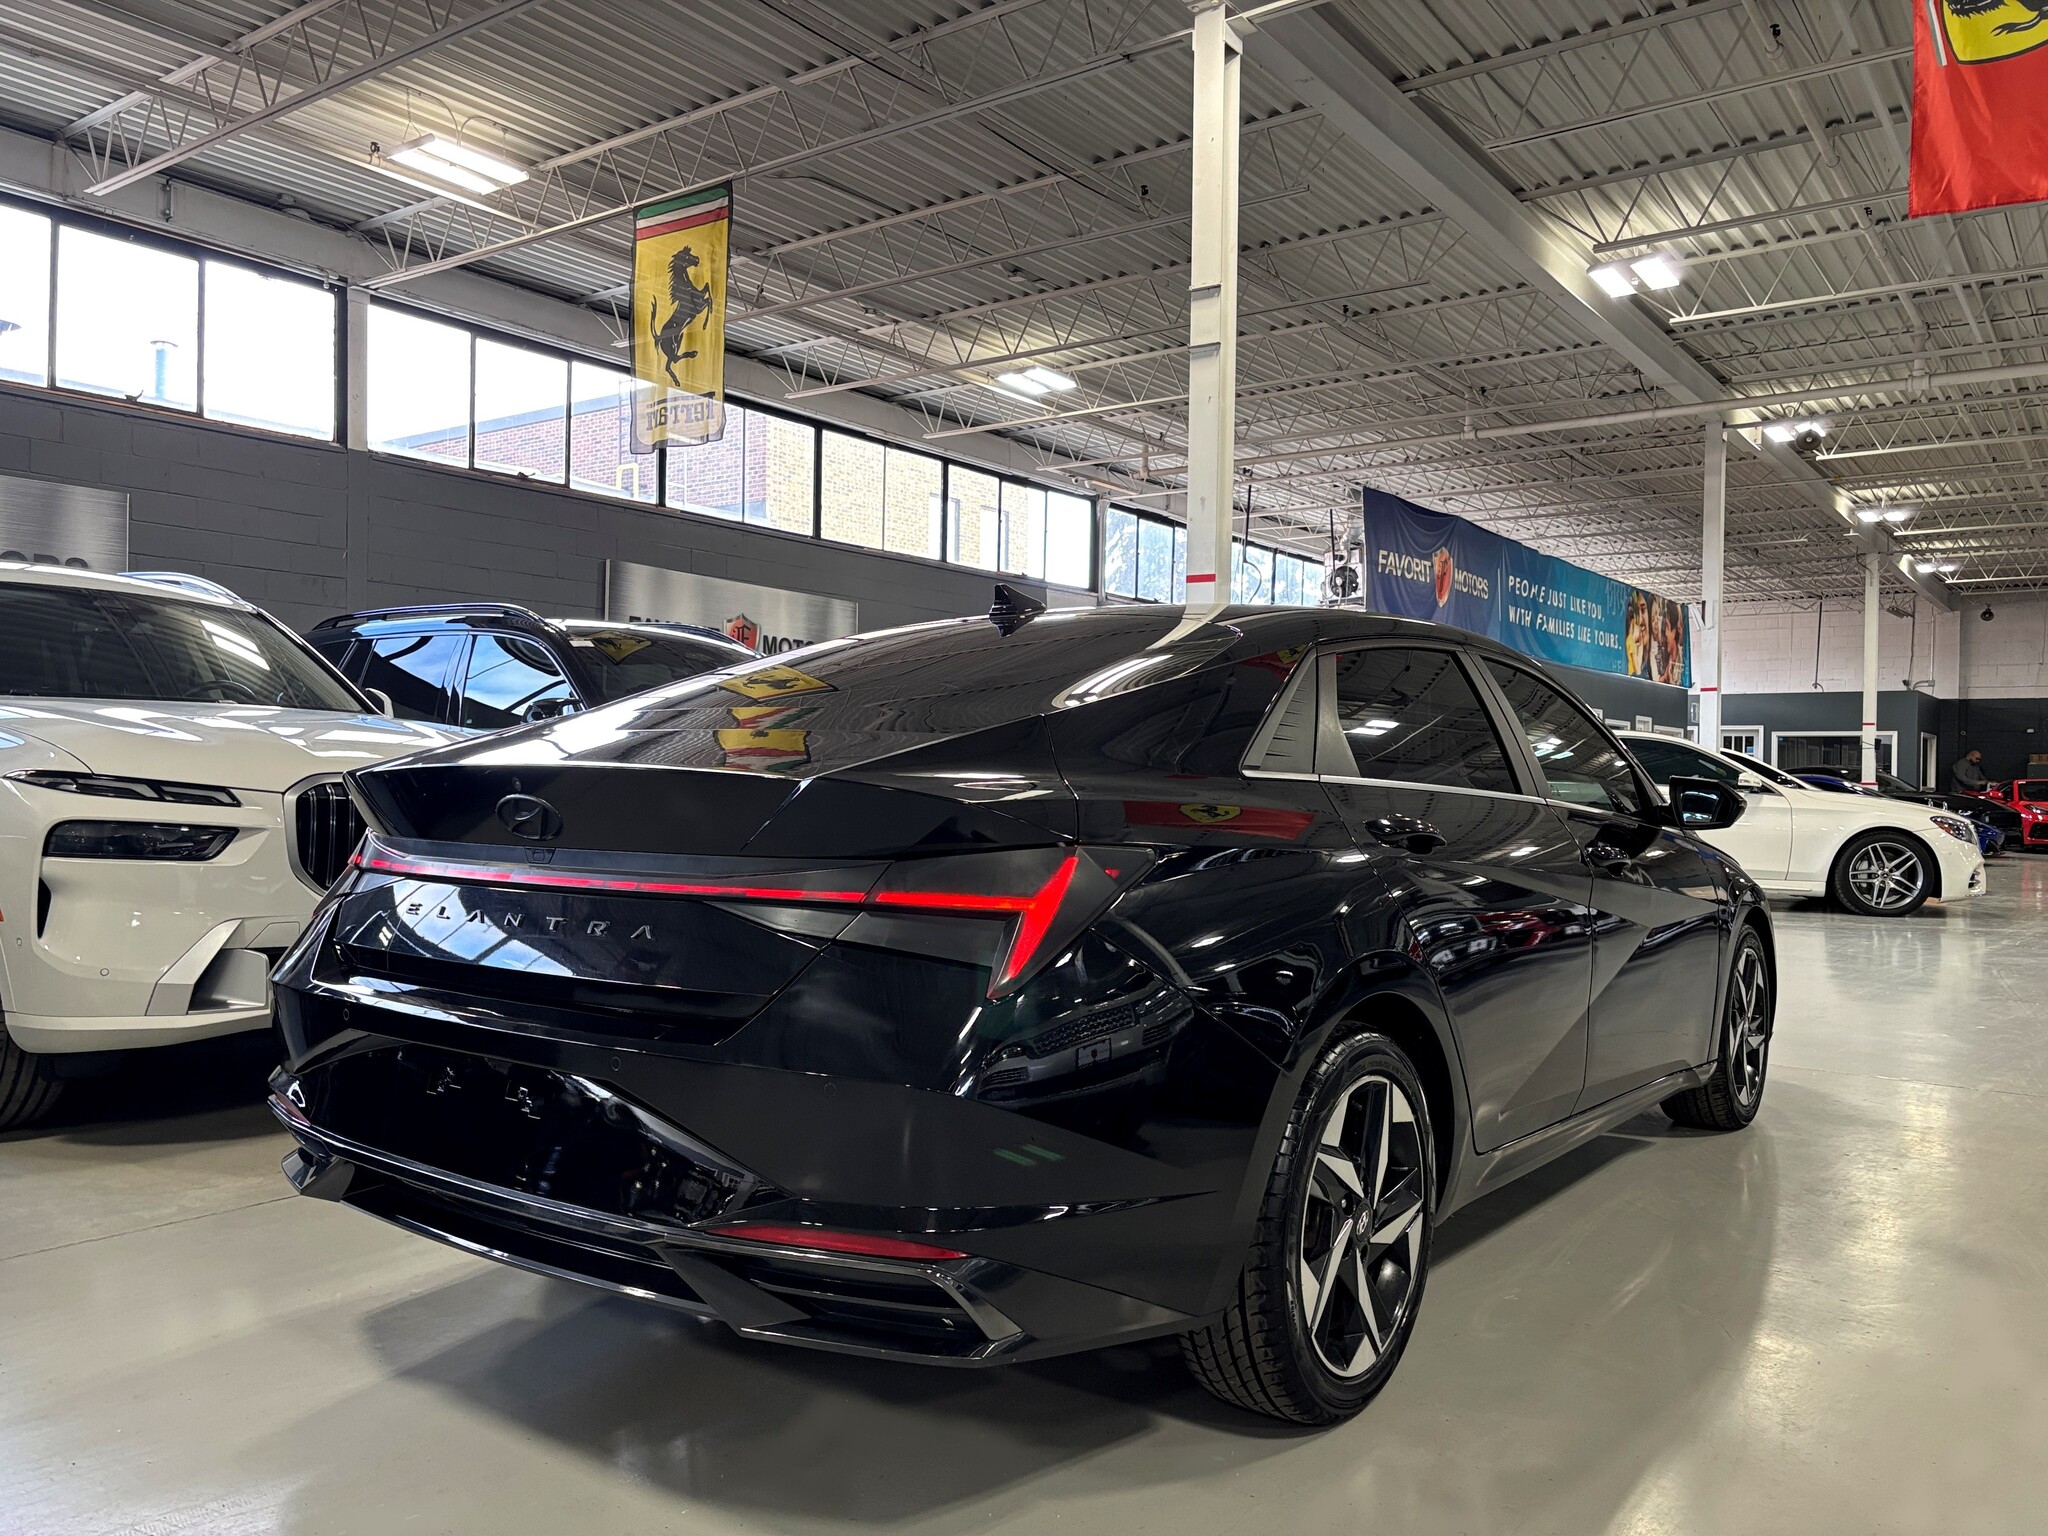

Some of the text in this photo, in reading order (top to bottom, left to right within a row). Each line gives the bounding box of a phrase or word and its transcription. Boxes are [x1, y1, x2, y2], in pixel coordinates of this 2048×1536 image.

[1378, 550, 1431, 583] FAVORIT
[1454, 568, 1488, 599] MOTORS
[1547, 589, 1567, 609] JUST
[1570, 595, 1586, 615] LIKE
[1587, 601, 1605, 623] YOU,
[763, 634, 815, 655] MOT
[1508, 605, 1622, 650] WITH FAMILIES LIKE YOURS.
[406, 903, 654, 940] ELANTRA
